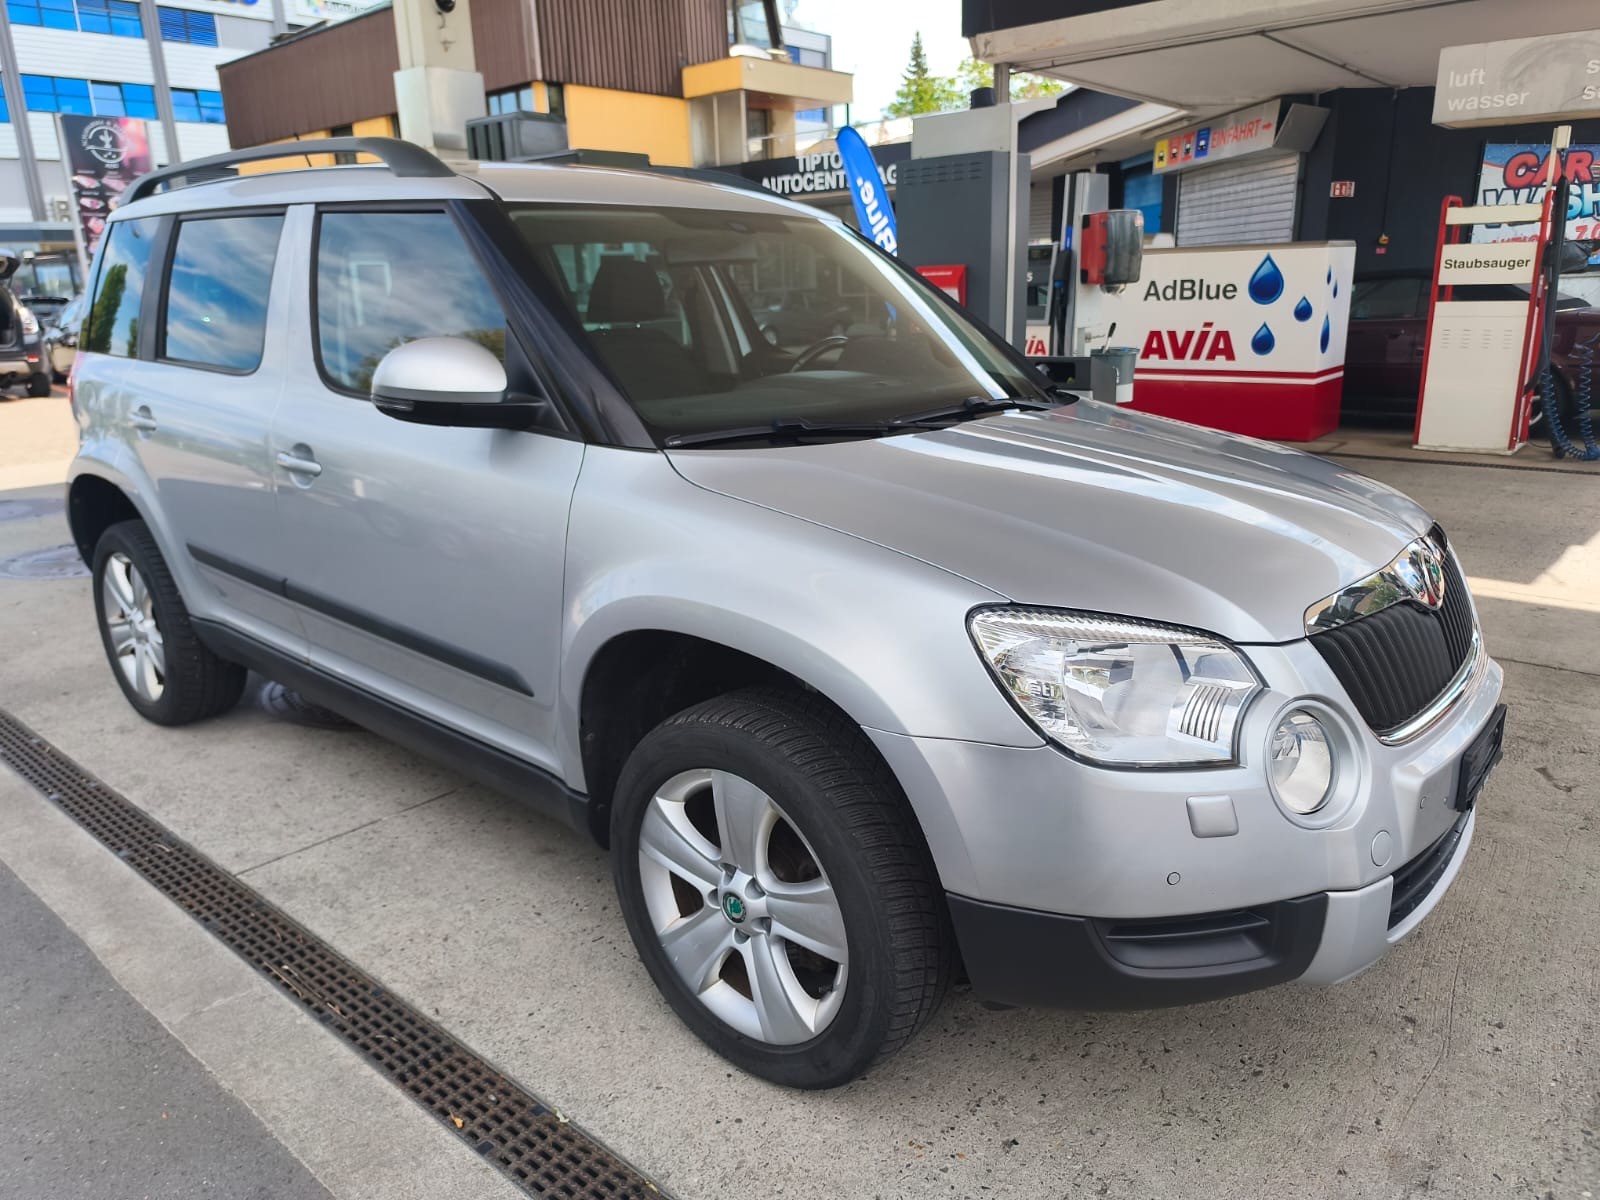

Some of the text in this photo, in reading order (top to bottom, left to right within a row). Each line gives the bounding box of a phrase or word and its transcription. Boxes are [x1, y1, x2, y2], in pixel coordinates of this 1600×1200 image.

[1449, 68, 1487, 89] luft
[1447, 91, 1530, 112] wasser
[1210, 118, 1262, 149] EINFAHRT
[795, 152, 844, 173] TIPTO
[1503, 149, 1594, 189] CAR
[762, 169, 850, 195] AUTOCENT
[1444, 258, 1531, 271] Staubsauger
[1144, 279, 1238, 301] AdBlue
